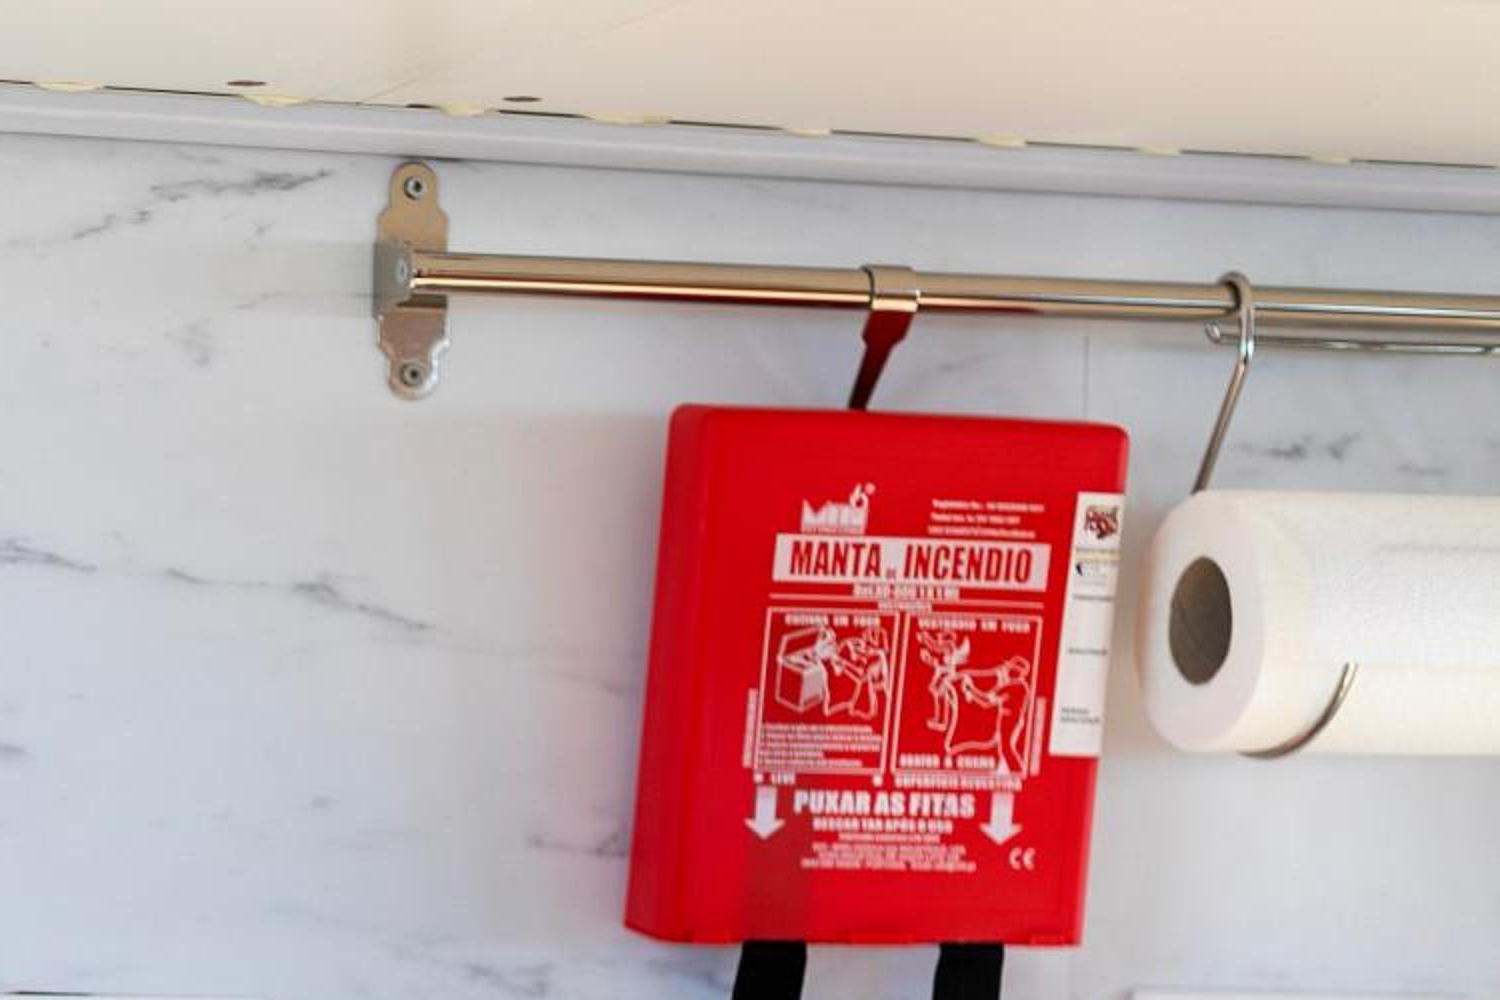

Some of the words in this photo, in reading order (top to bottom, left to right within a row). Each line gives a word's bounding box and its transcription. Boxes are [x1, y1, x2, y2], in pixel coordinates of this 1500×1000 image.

[790, 540, 881, 577] MANTA
[904, 543, 1033, 583] INCENDIO
[794, 788, 871, 815] PUXAR
[873, 791, 905, 817] AS
[908, 791, 976, 819] FITAS
